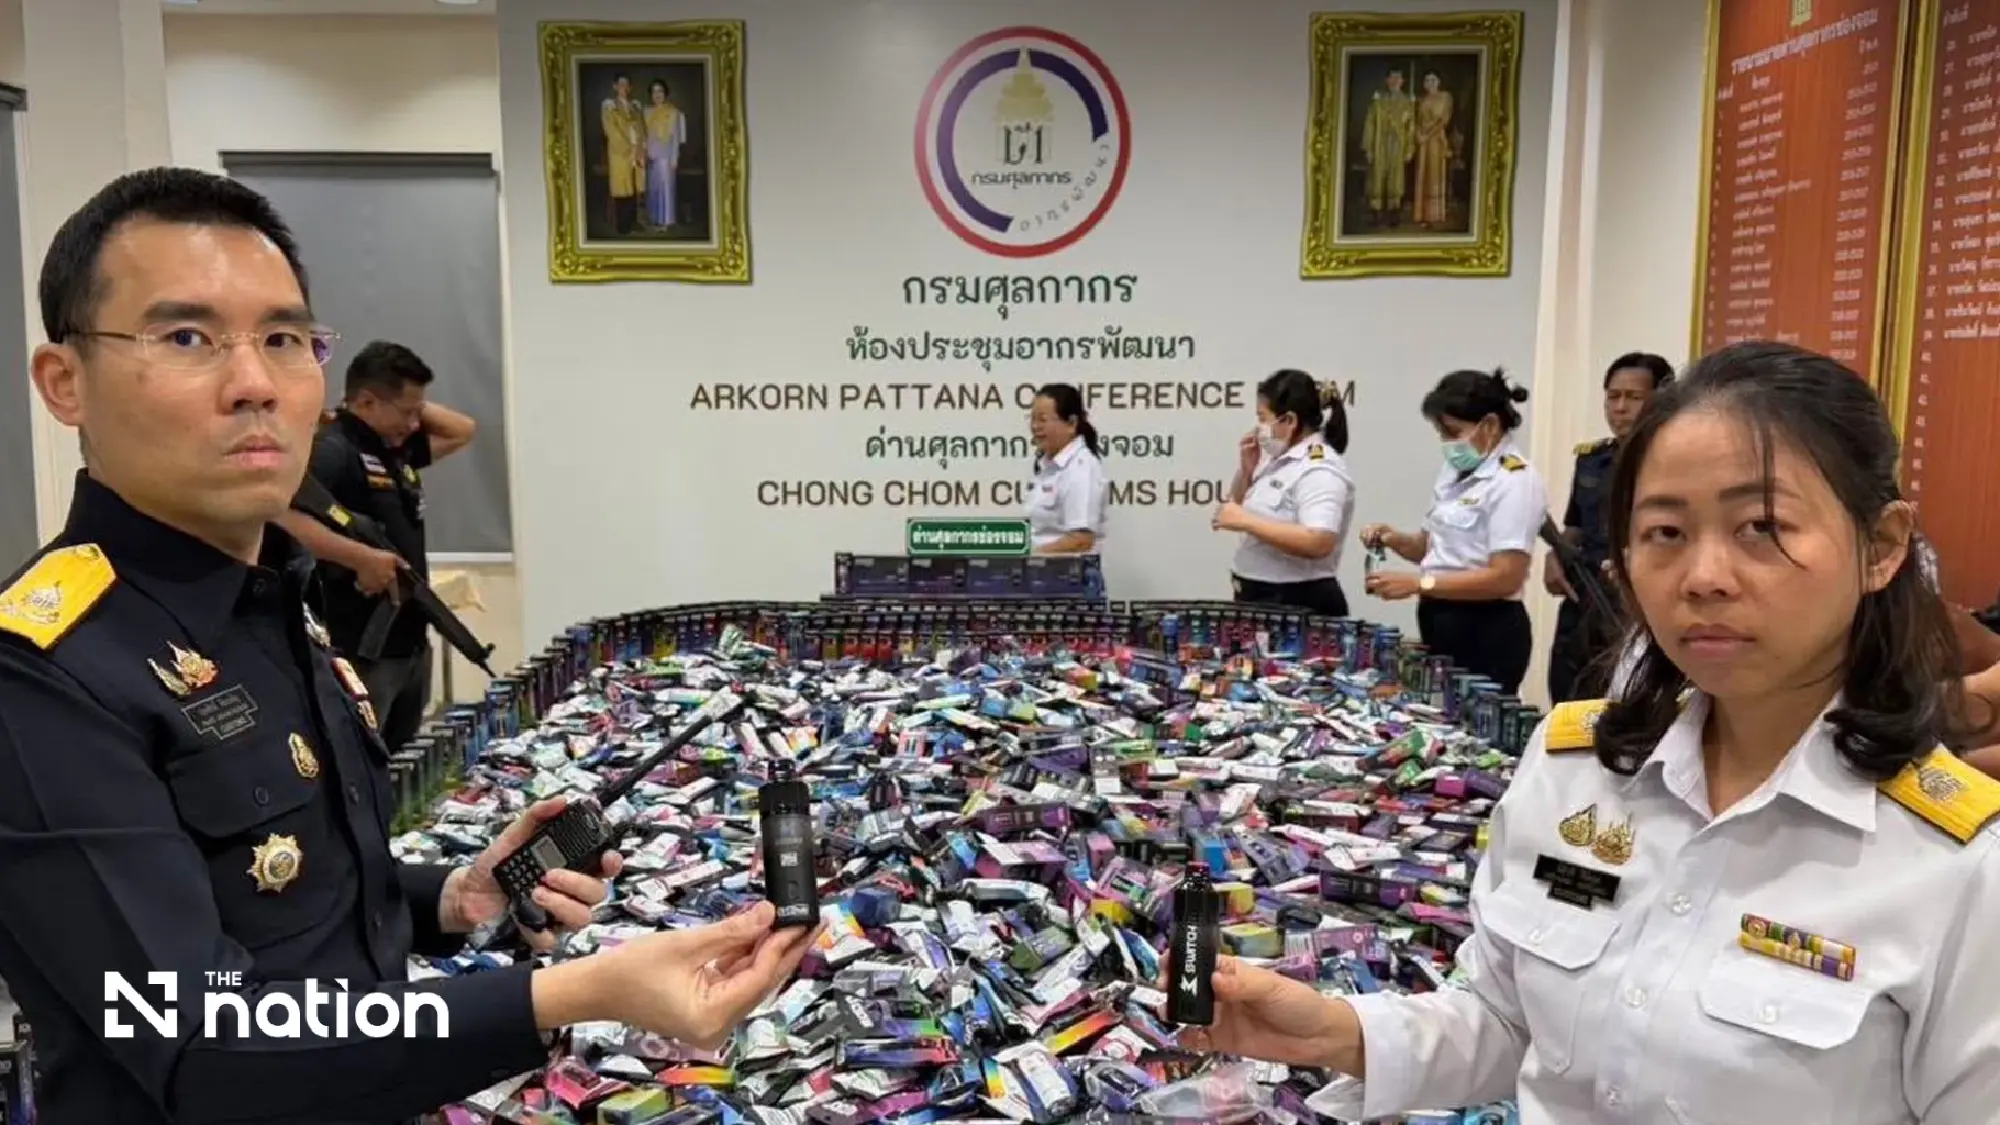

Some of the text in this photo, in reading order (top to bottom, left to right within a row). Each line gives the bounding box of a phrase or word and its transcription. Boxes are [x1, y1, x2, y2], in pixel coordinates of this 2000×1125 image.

[971, 170, 1072, 190] กรมศุลกากร
[902, 274, 1137, 320] กรมศุลกากร
[846, 325, 1195, 372] ห้องประชุมอากรพัฒนา
[690, 383, 828, 410] ARKORN
[840, 383, 1004, 410] PATTANA
[1015, 382, 1245, 410] CFERENCE
[757, 480, 874, 506] CHONG
[884, 480, 981, 506] CHOM
